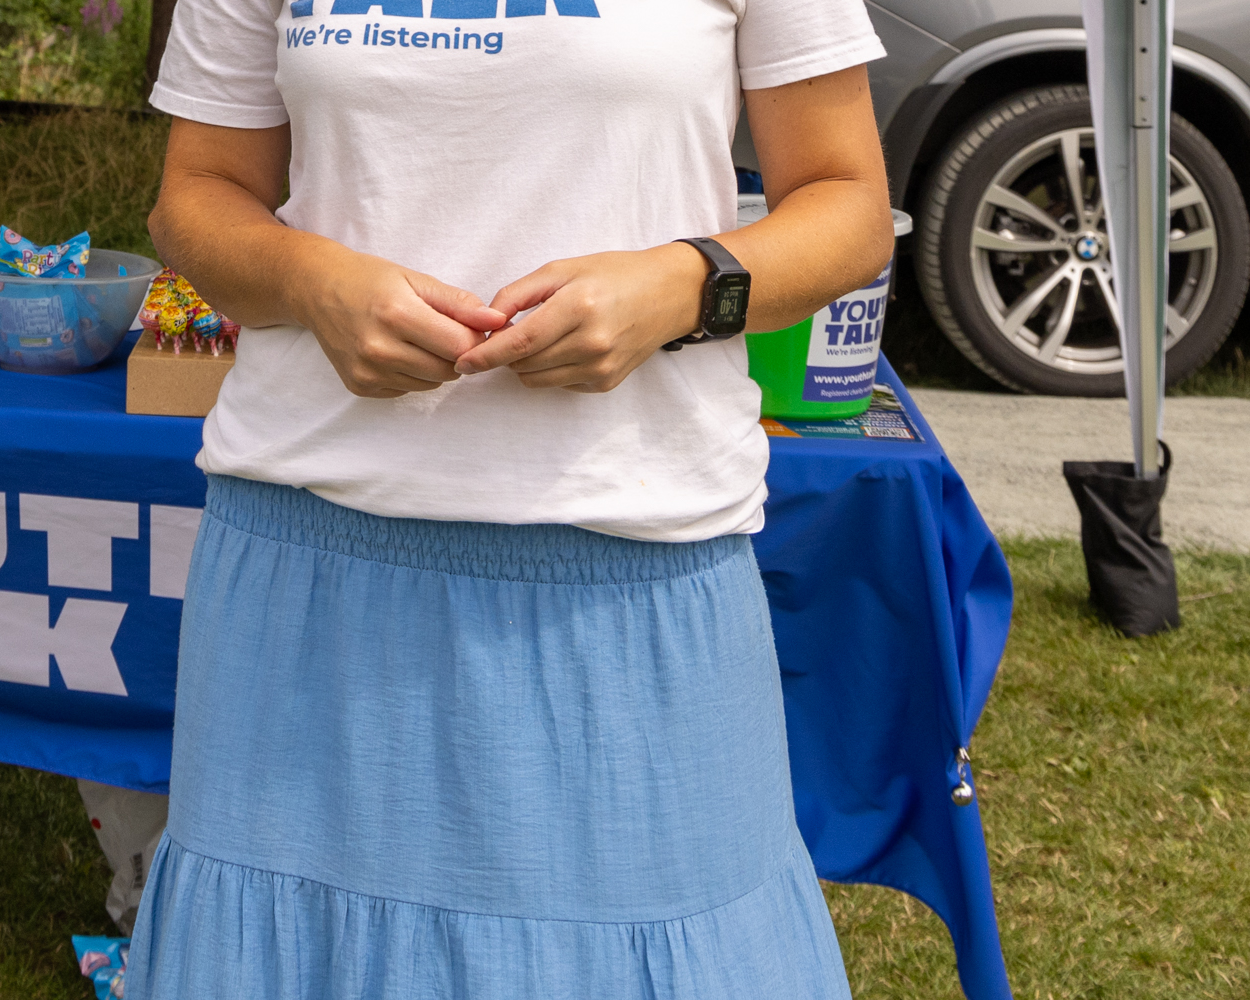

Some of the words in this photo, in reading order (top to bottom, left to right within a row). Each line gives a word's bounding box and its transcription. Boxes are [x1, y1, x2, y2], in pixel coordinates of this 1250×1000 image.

[286, 24, 352, 49] We're
[363, 23, 503, 55] listening
[720, 298, 738, 315] 1:40
